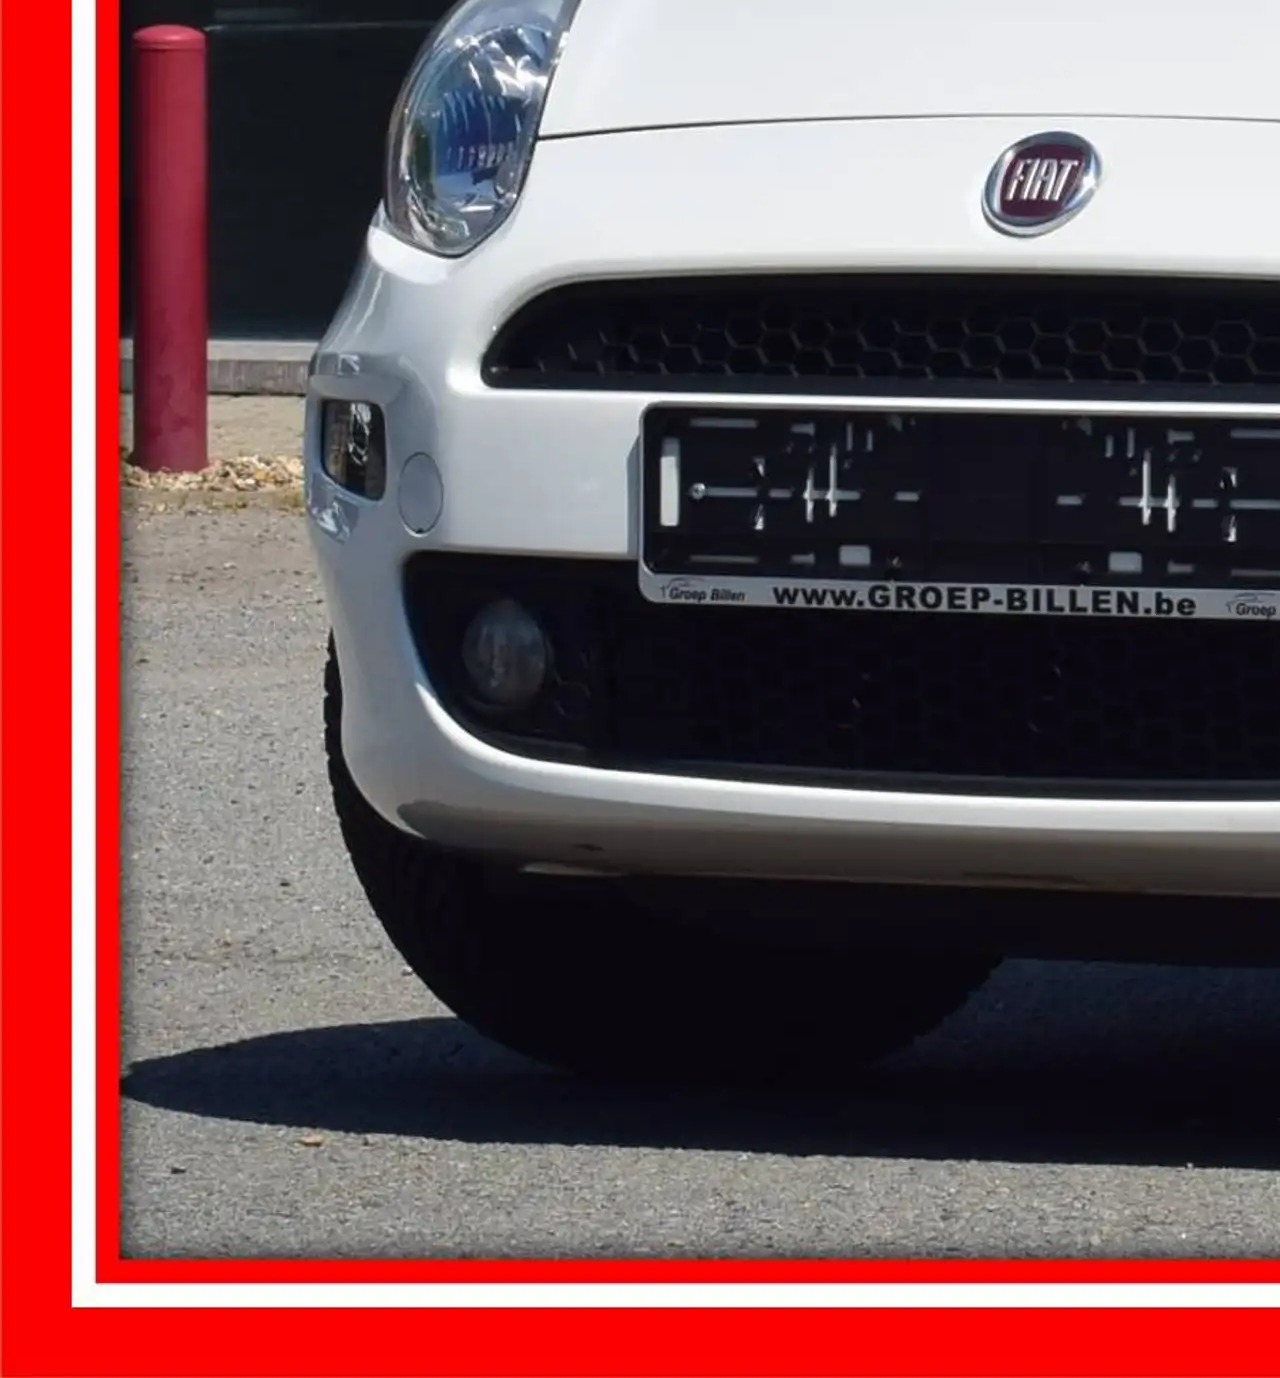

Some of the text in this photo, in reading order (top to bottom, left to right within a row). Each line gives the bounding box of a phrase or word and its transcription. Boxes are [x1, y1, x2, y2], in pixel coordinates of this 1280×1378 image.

[1005, 158, 1079, 201] FIAT
[668, 585, 746, 603] Groep Billen
[772, 584, 1198, 617] www.GROEP-BILLEN.be
[1235, 602, 1277, 619] Groep
